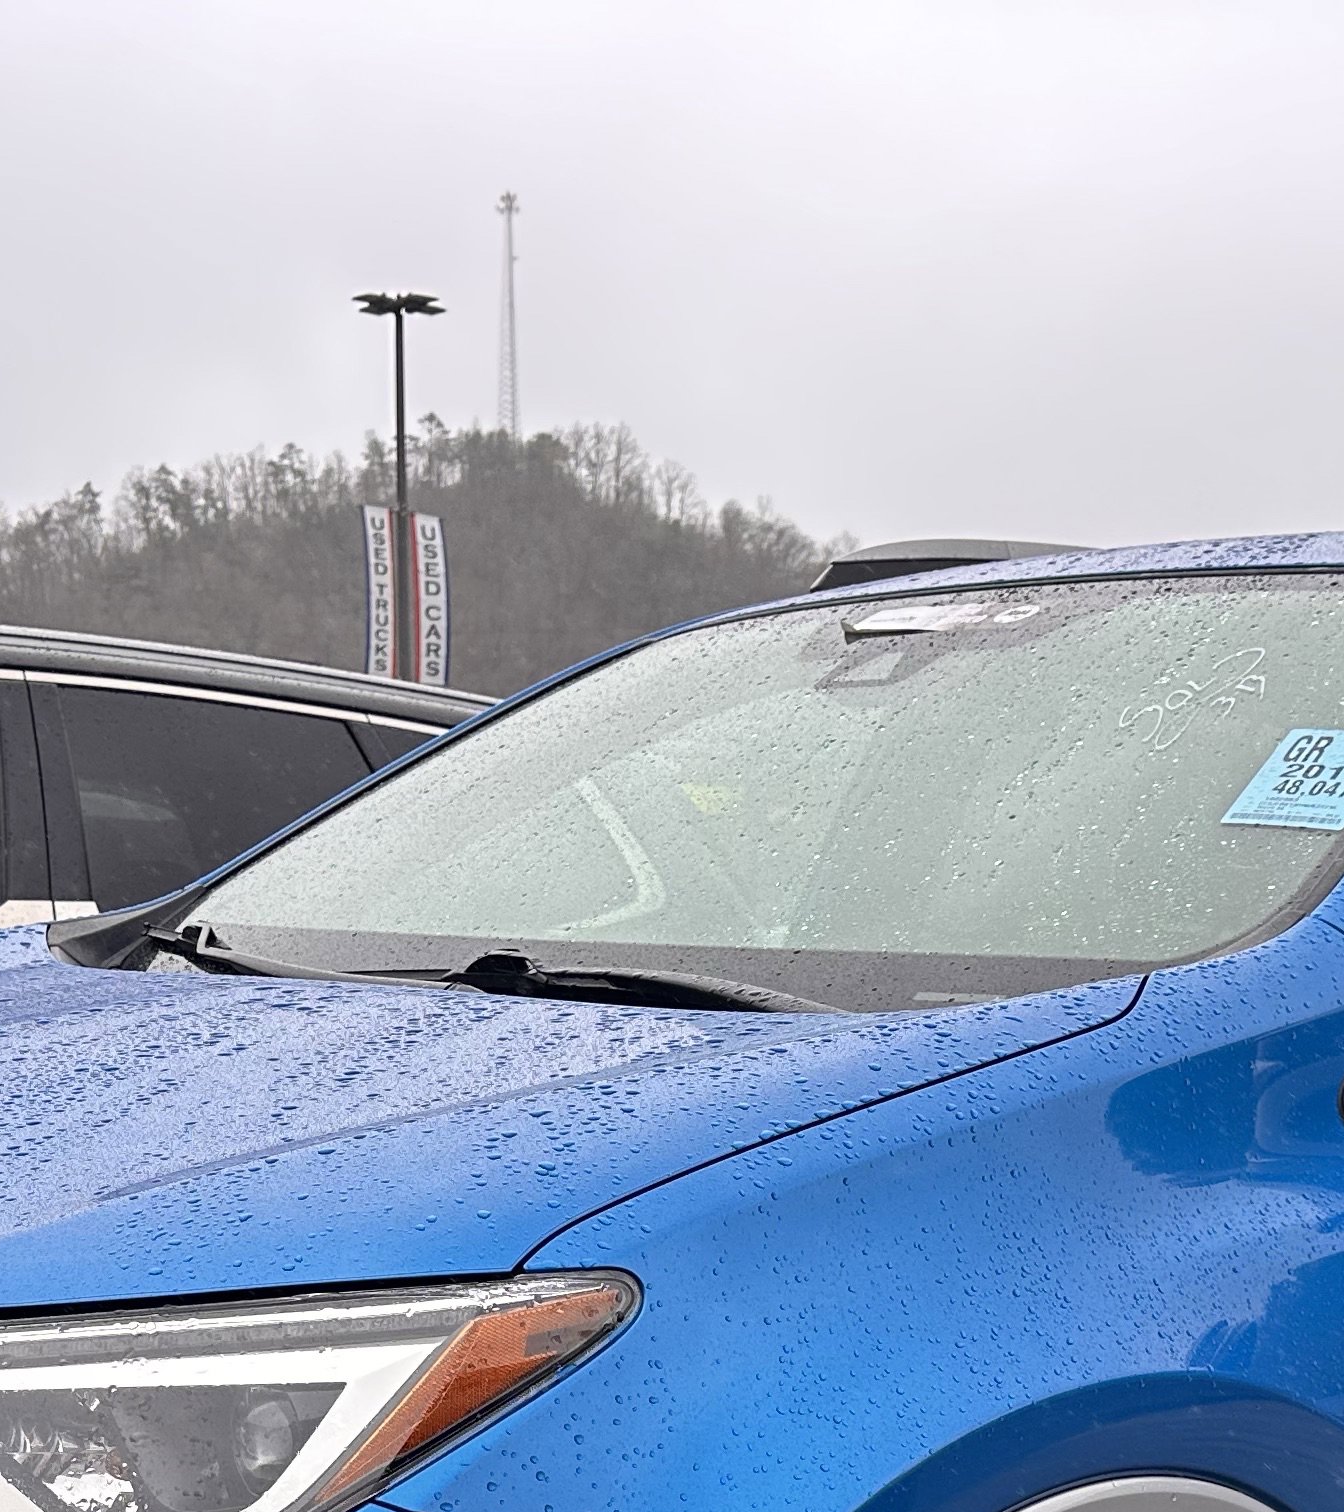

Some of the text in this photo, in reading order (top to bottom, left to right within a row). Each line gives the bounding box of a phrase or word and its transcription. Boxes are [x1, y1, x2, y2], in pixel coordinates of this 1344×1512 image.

[370, 516, 389, 672] USED TRUCKS
[420, 524, 442, 677] USED CARS
[1283, 735, 1335, 763] GR
